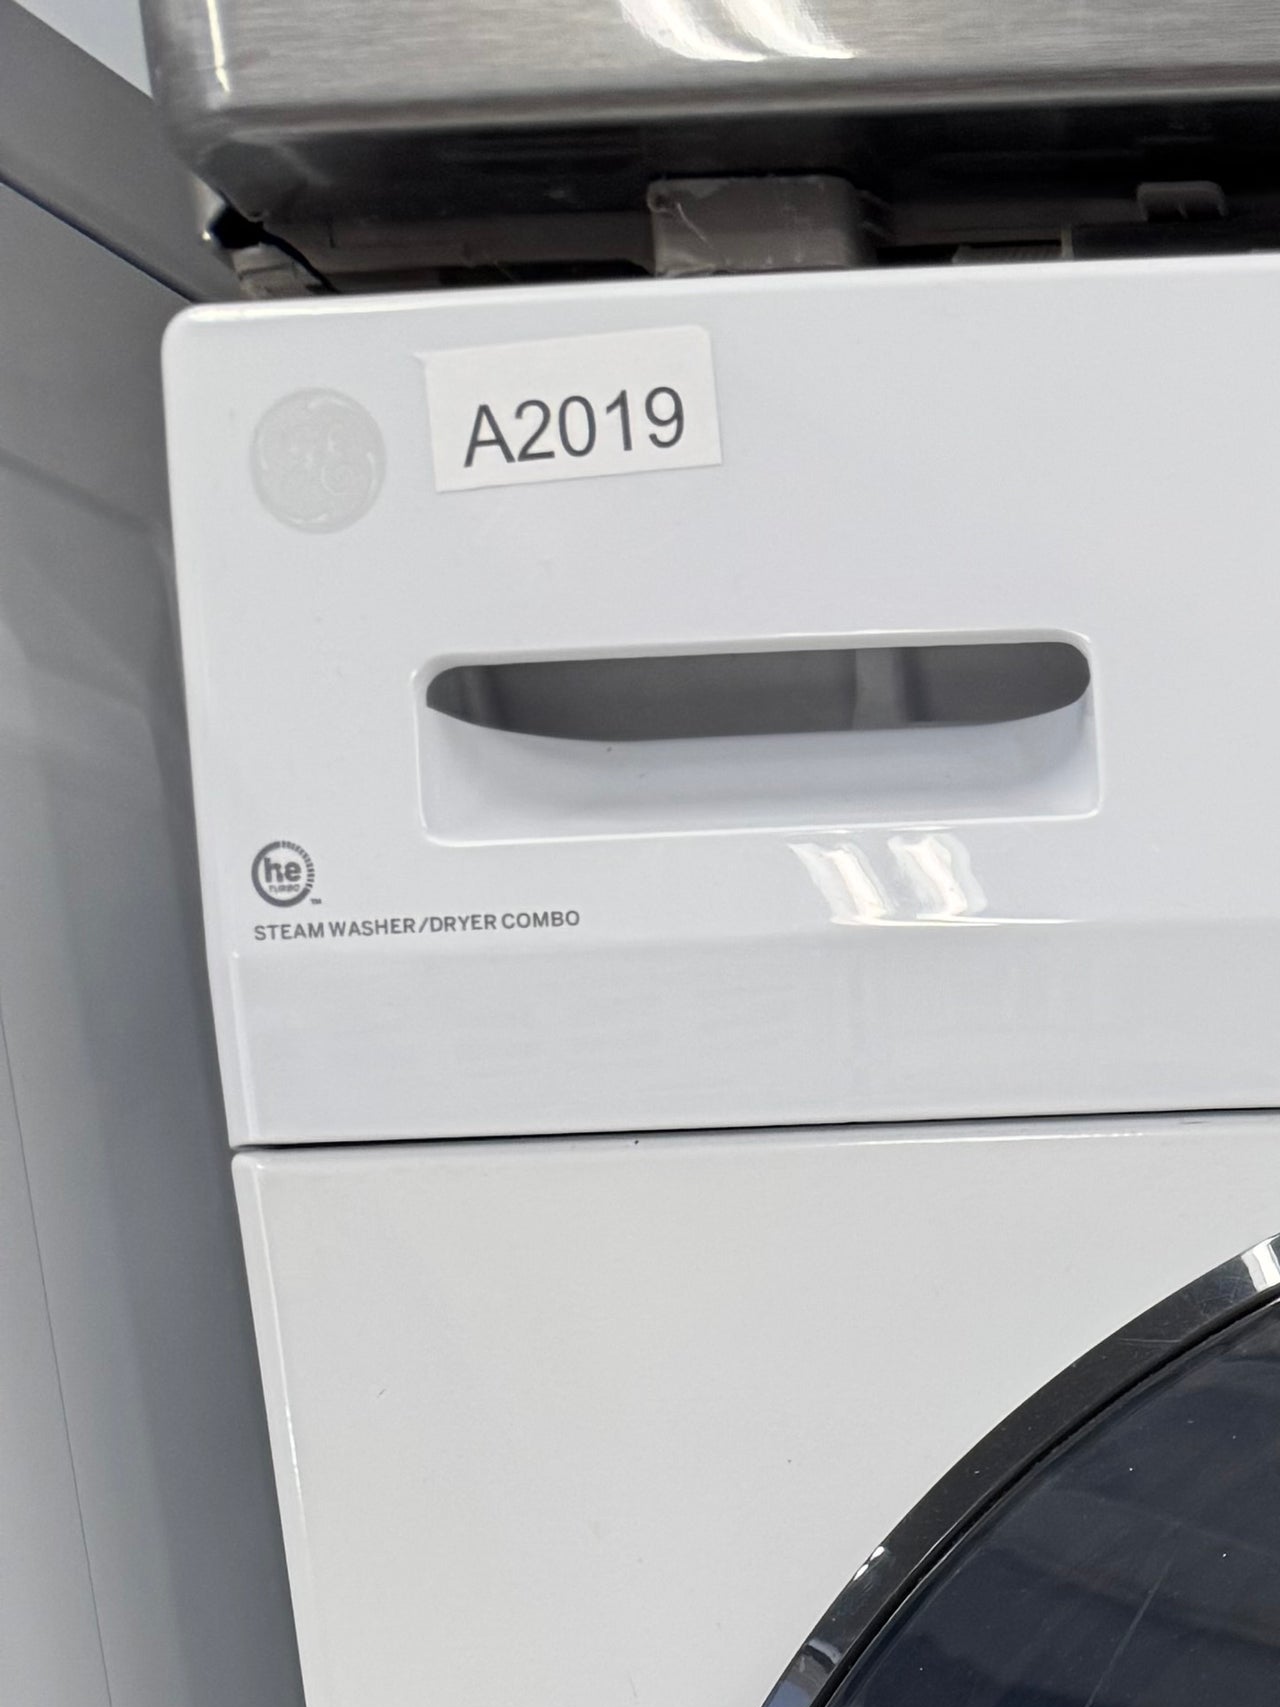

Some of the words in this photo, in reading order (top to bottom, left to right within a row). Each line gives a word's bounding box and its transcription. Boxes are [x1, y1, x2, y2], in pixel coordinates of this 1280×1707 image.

[464, 387, 684, 467] A2019
[264, 857, 302, 883] he
[255, 922, 324, 940] STEAM
[328, 914, 496, 937] WASHER/DRYER
[502, 911, 579, 929] COMBO
